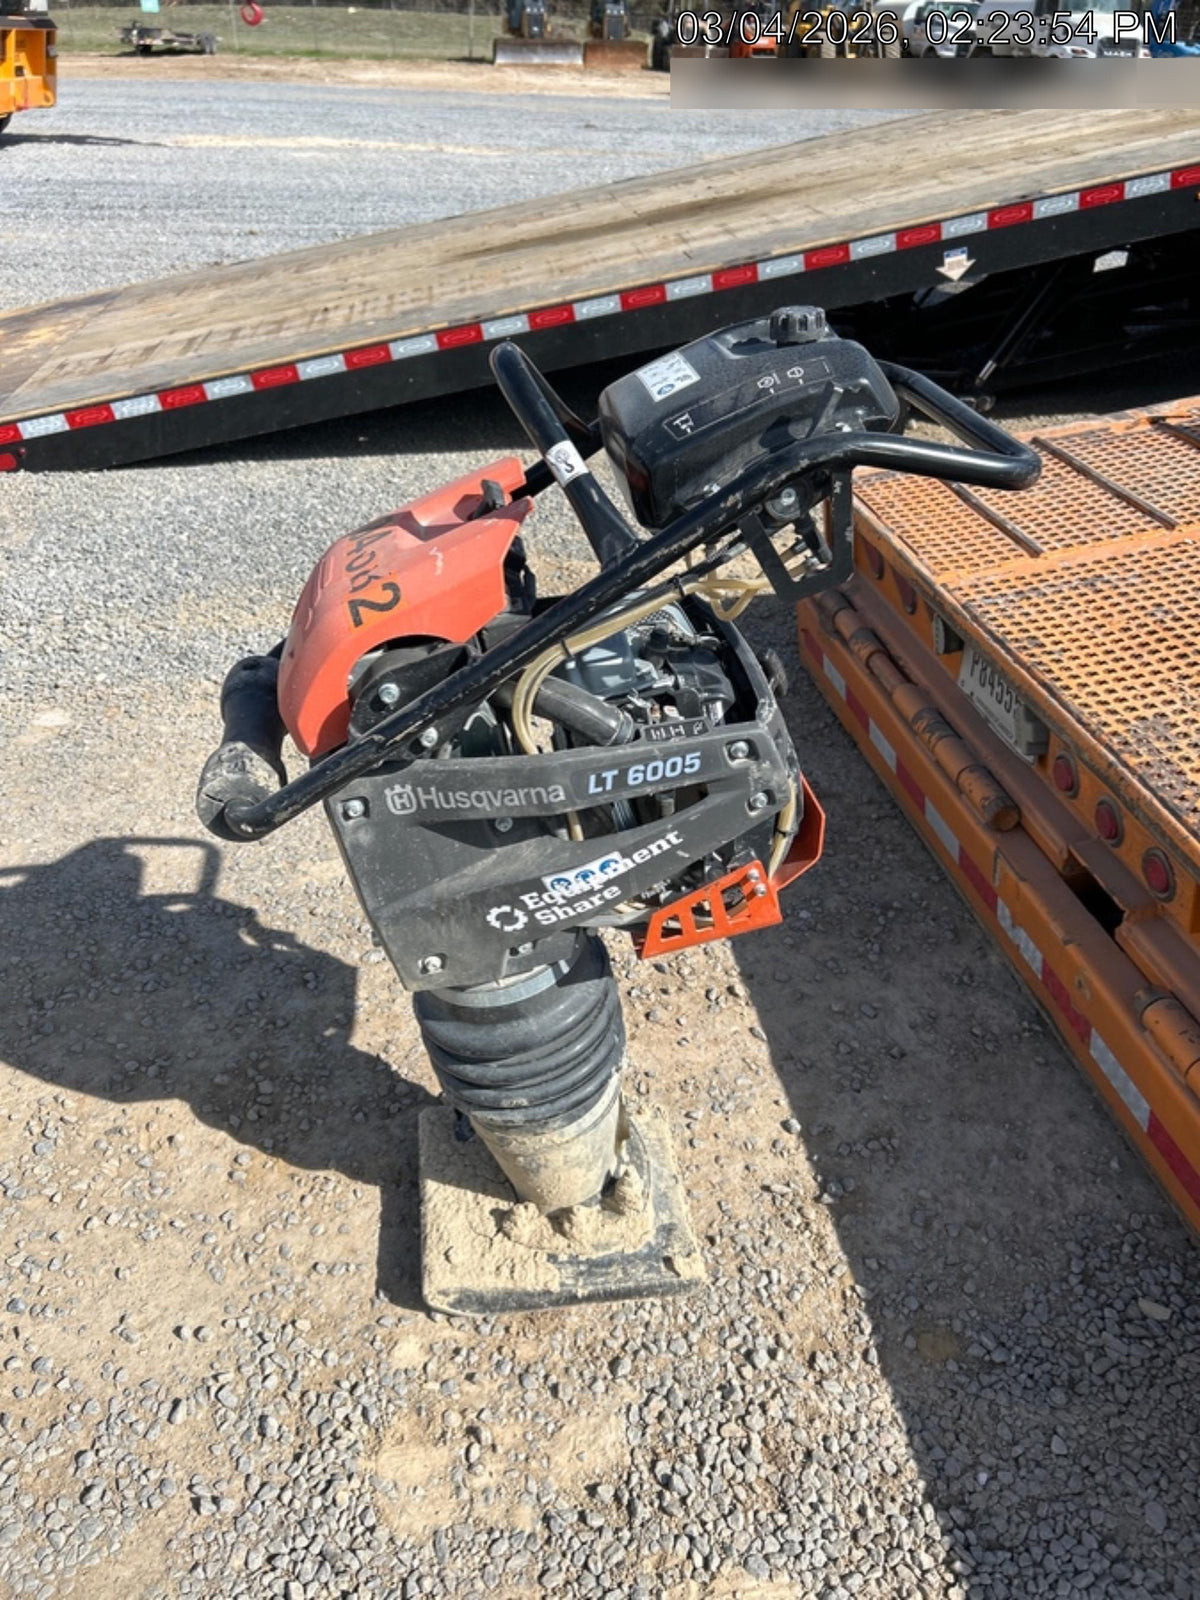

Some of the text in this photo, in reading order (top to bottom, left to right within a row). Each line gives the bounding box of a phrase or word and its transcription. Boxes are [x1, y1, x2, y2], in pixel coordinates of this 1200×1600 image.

[588, 752, 701, 794] LT 6005
[416, 784, 566, 811] Husqvarna
[534, 885, 621, 925] Share
